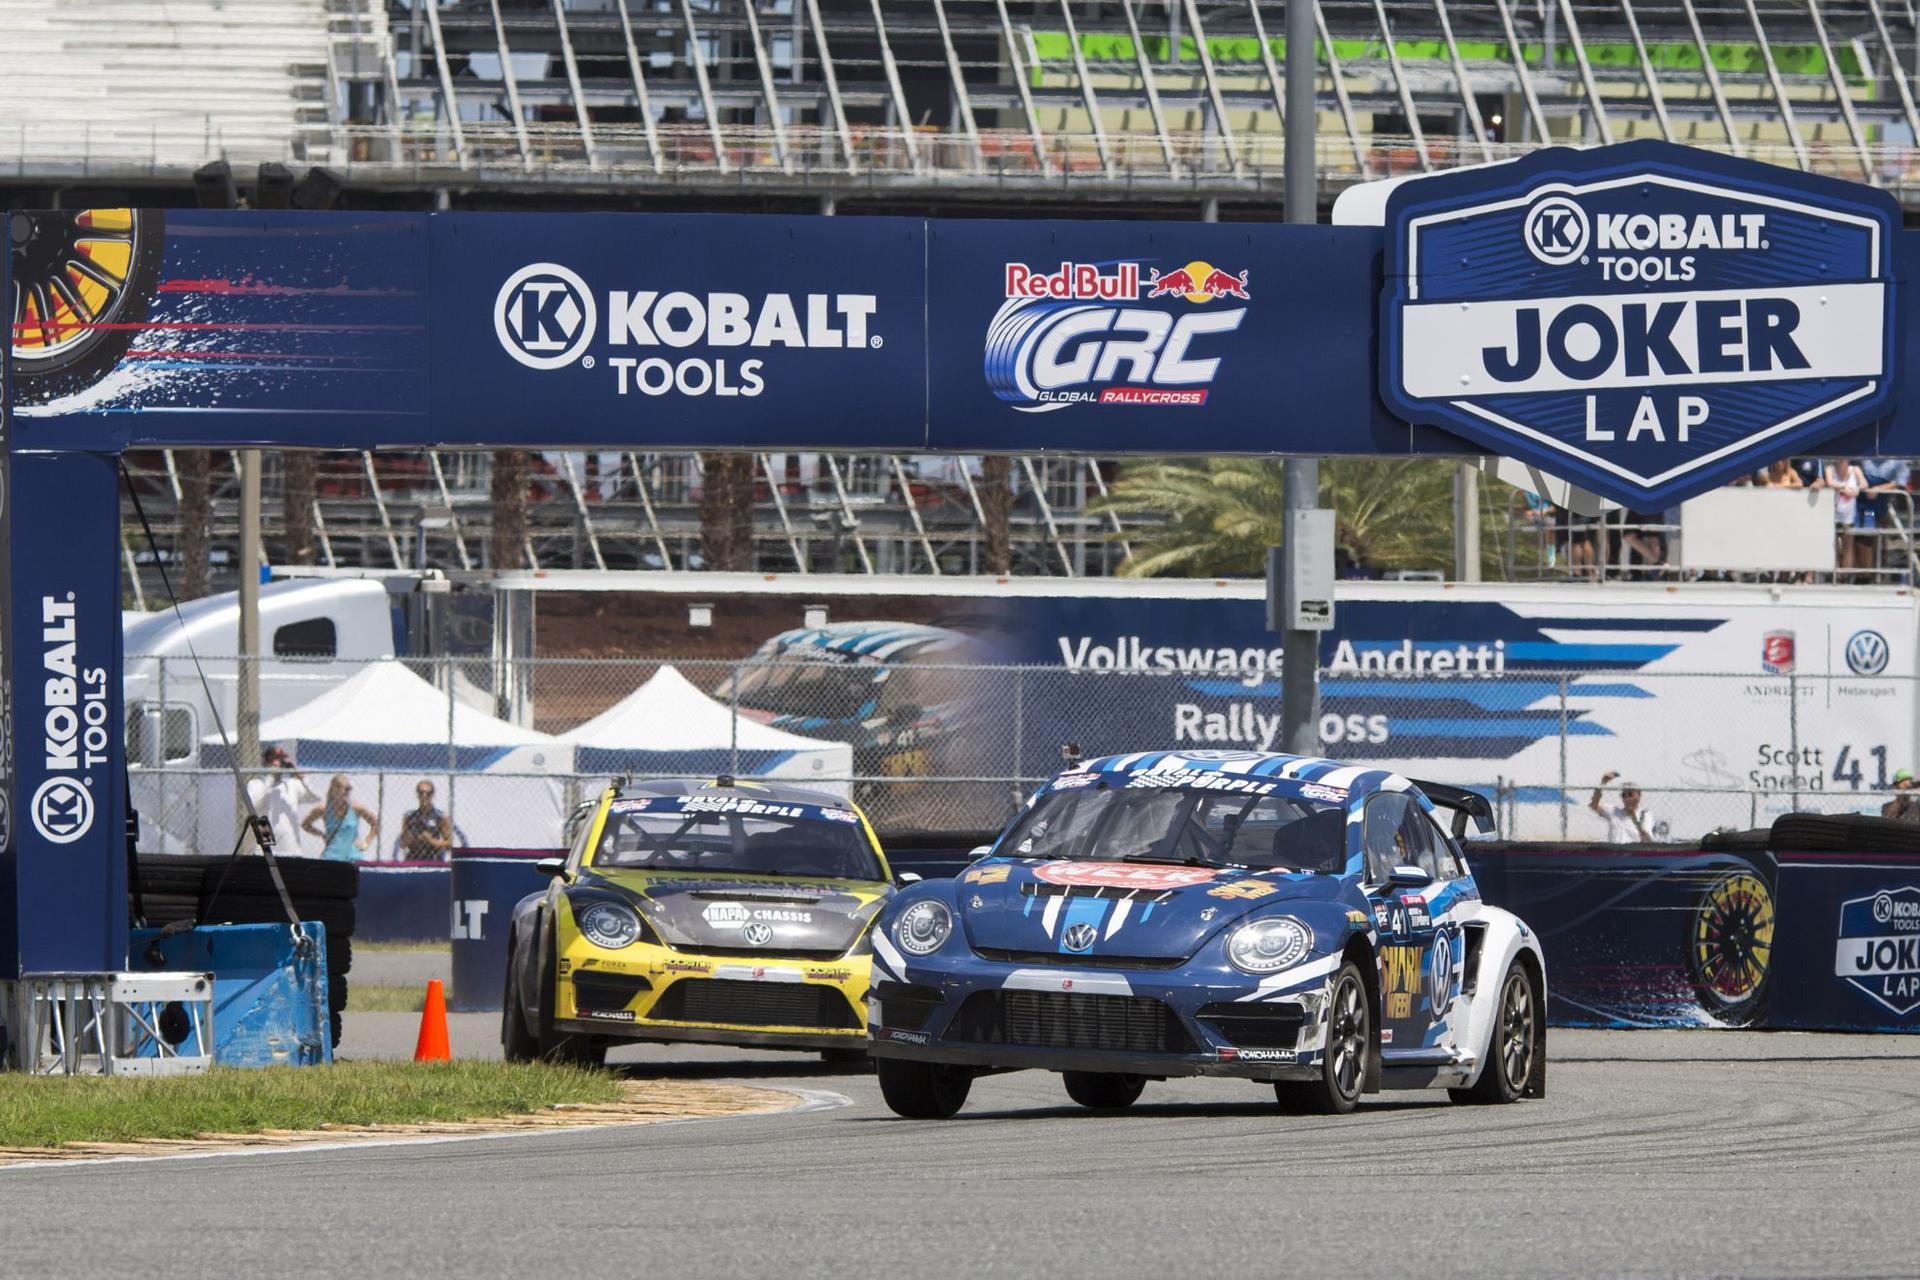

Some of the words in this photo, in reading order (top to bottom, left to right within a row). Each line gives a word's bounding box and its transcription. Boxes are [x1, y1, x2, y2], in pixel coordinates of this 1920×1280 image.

[1598, 214, 1766, 250] KOBALT
[1005, 262, 1071, 299] Red
[1076, 262, 1139, 300] Bull
[1599, 256, 1696, 281] TOOLS
[609, 291, 877, 348] KOBALT
[1033, 308, 1247, 389] GRC
[1482, 299, 1811, 383] JOKER
[609, 357, 765, 397] TOOLS
[1038, 391, 1098, 403] GLOBAL
[1102, 391, 1201, 404] RALLYCROSS
[1586, 396, 1710, 442] LAP
[1057, 636, 1284, 688] Volkswage
[1329, 639, 1505, 679] Andretti
[43, 596, 79, 770] KOBALT
[83, 667, 108, 769] TOOLS
[1174, 703, 1389, 752] Rallyoss
[1172, 776, 1277, 794] PURPLE
[1758, 744, 1823, 767] Scott
[1832, 745, 1893, 790] 41
[722, 801, 804, 818] PURPLE
[451, 900, 489, 940] LT
[709, 907, 743, 921] NAPA
[753, 909, 812, 923] CHASSIS
[1894, 902, 1920, 917] KOB
[1856, 940, 1920, 971] JOK
[1883, 976, 1920, 997] LAP
[1237, 1050, 1295, 1062] YOKOHAMA
